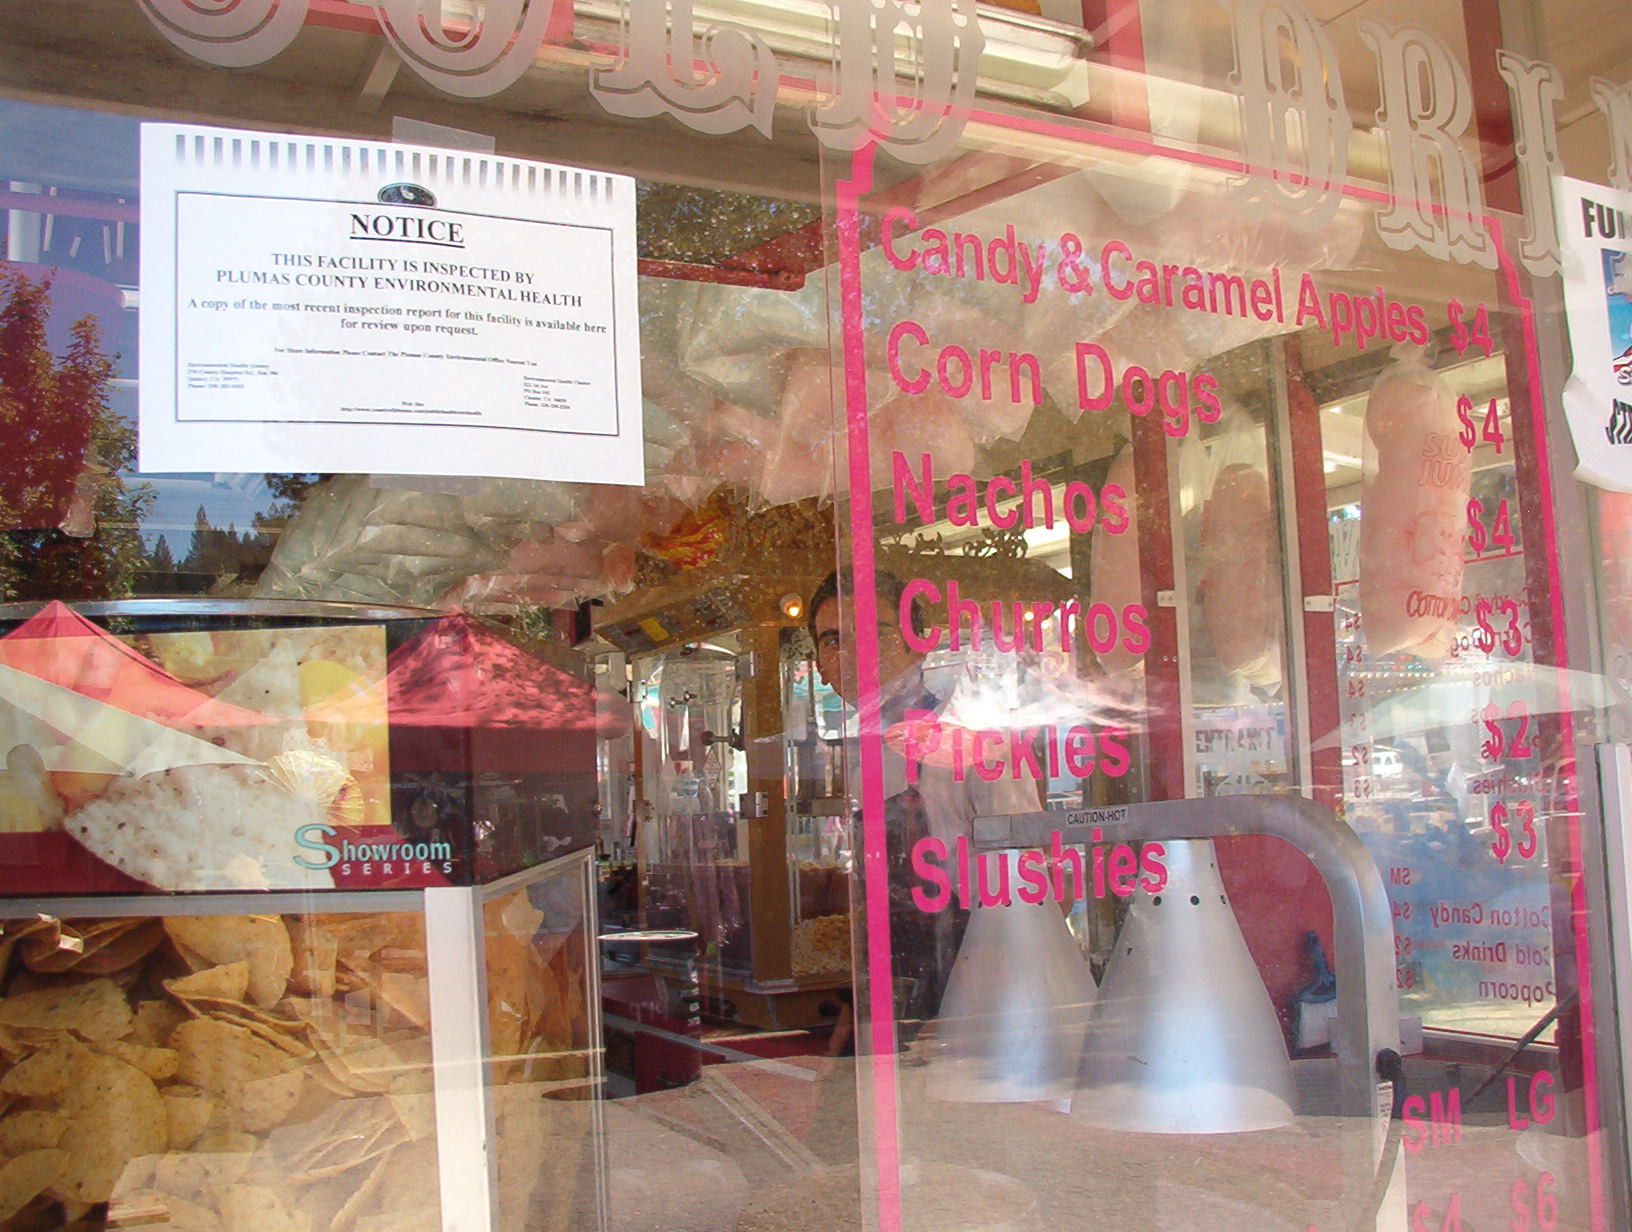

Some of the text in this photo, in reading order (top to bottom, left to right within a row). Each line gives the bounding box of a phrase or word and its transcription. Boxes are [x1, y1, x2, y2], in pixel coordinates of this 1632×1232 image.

[141, 0, 984, 164] LD
[350, 213, 464, 243] NOTICE
[216, 269, 582, 308] PLUMAS COUNTY ENVIRONMENTAL HEALTH
[271, 253, 534, 285] THIS FACILITY IS INSPECTED BY
[881, 206, 1493, 358] Candy & Caramel Apples $4
[187, 298, 607, 334] A copy of the most recent inspection report for this facility is available here
[340, 318, 479, 338] for review upon request.
[887, 320, 1043, 405] Corn
[1074, 342, 1223, 438] Dogs
[1456, 393, 1504, 454] $4
[892, 450, 1514, 558] Nachos $4
[899, 578, 1522, 660] Churros $3
[903, 700, 1532, 784] Pickles $2
[293, 824, 450, 870] Showroom
[1067, 808, 1127, 825] CAUTION-HOT
[342, 861, 453, 876] SERIES
[910, 800, 1537, 914] Slushies $3
[1402, 1088, 1461, 1153] SM
[1506, 1070, 1556, 1131] LG
[1511, 1170, 1558, 1232] $6
